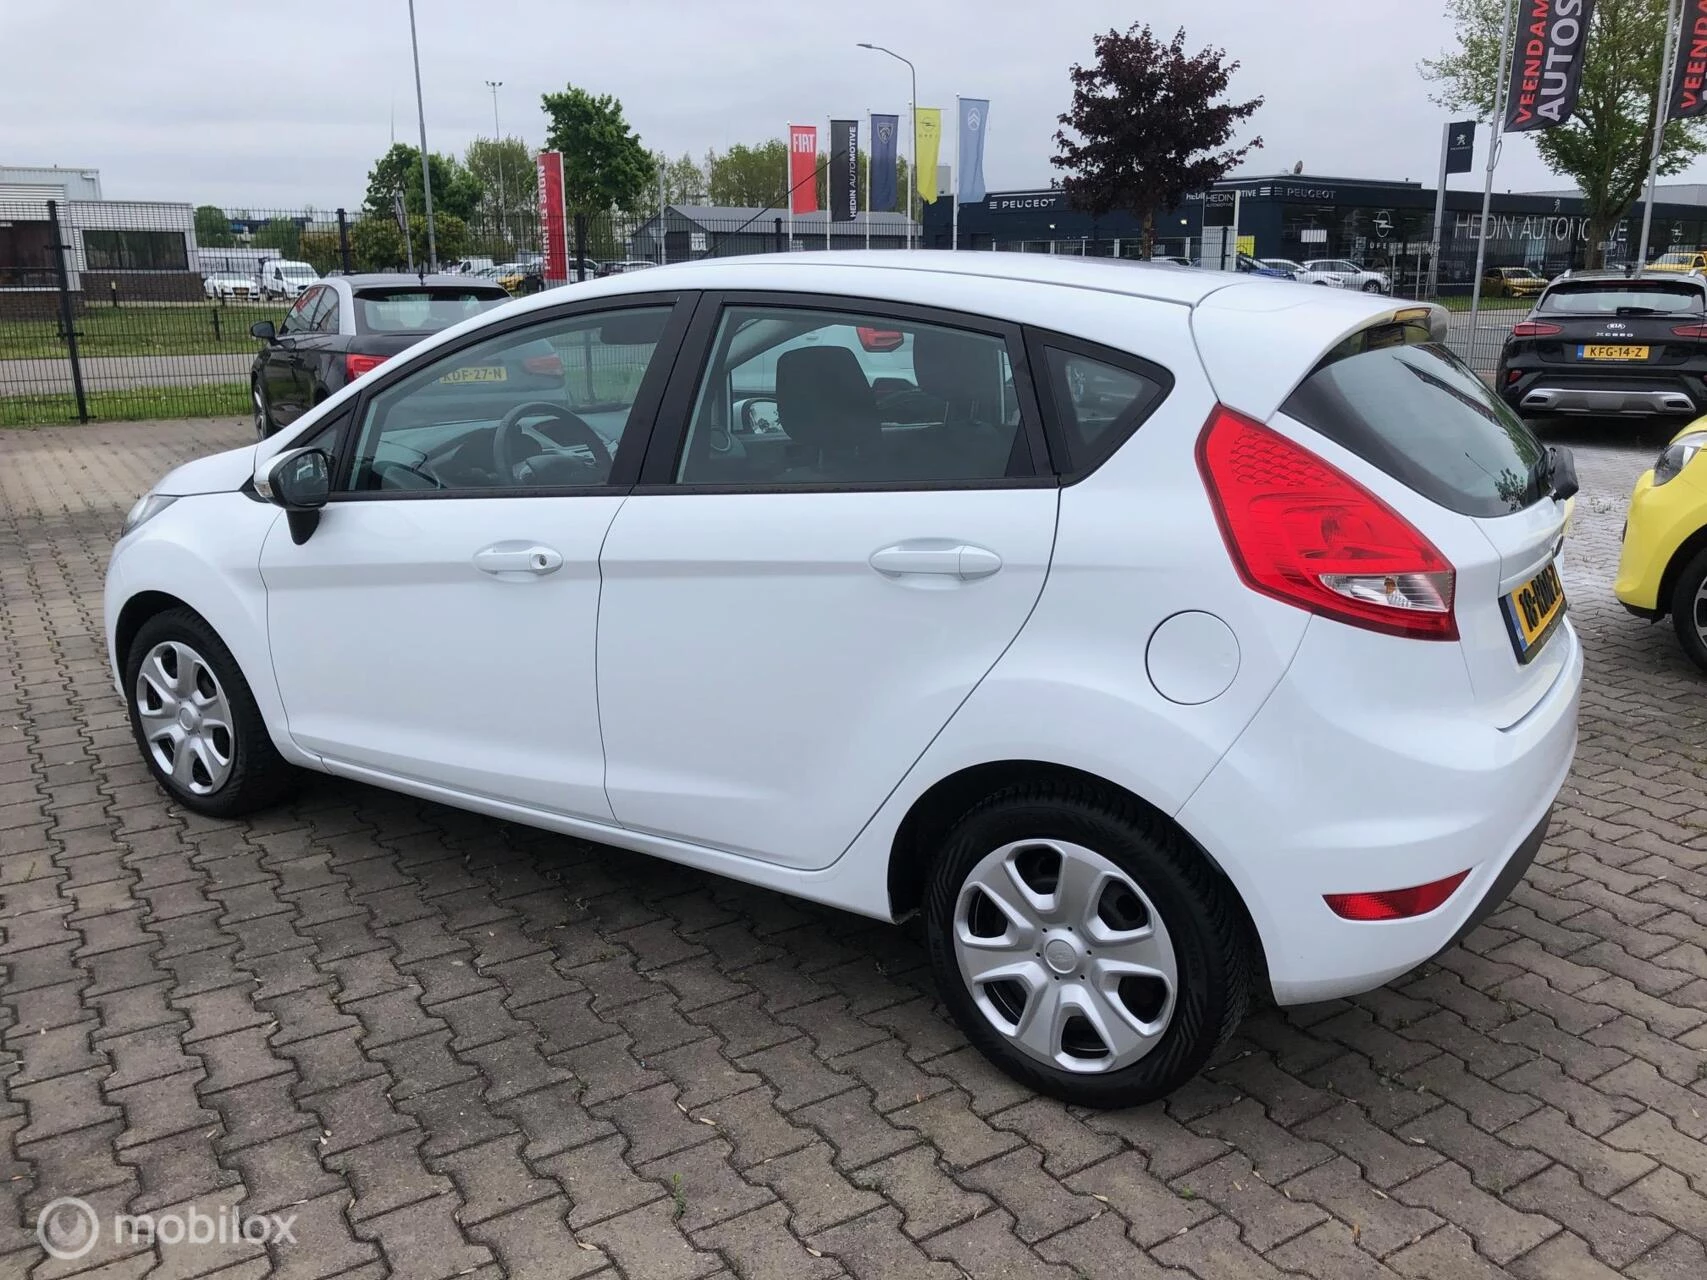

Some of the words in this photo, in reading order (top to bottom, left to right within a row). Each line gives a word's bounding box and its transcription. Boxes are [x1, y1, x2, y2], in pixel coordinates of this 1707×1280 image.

[792, 133, 816, 153] FIAT
[848, 126, 857, 188] AUTOMOTIVE
[1205, 193, 1235, 203] HEDIN
[1287, 187, 1337, 199] PEUGEOT
[849, 189, 857, 218] HEDIN
[1002, 198, 1056, 209] PEUGEOT
[1454, 212, 1515, 240] HEDIN
[1590, 346, 1643, 358] KFG-14-Z
